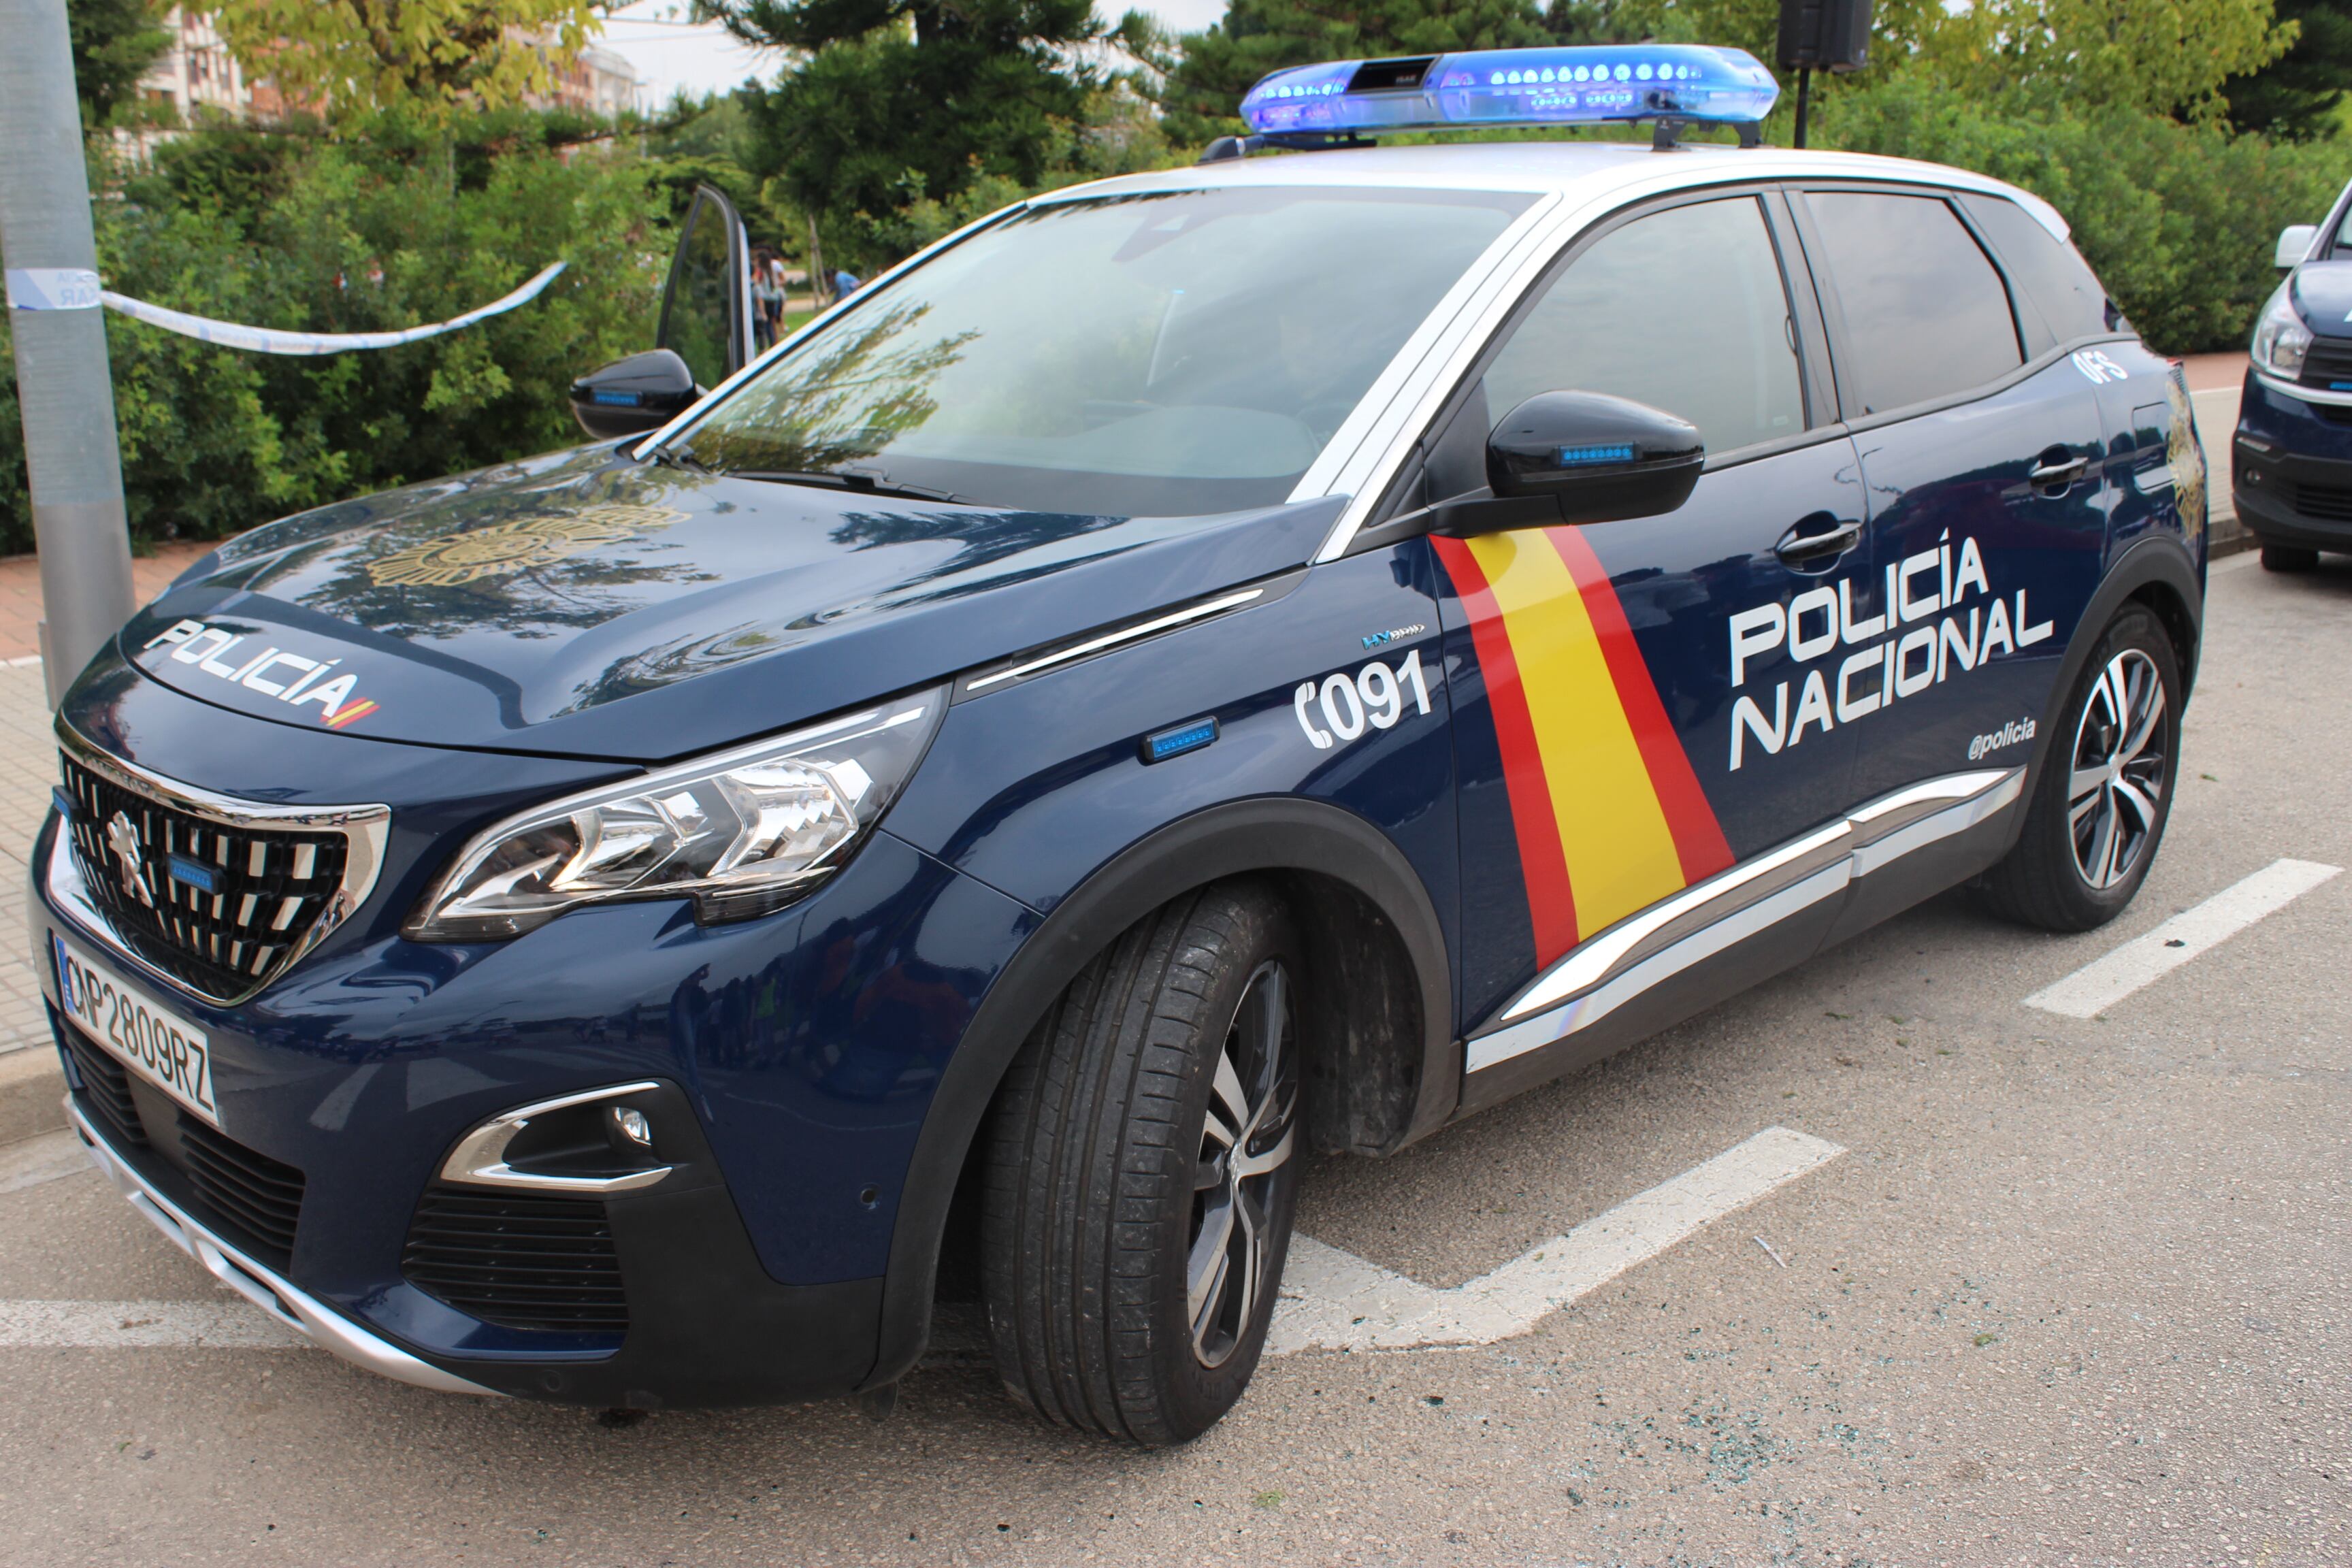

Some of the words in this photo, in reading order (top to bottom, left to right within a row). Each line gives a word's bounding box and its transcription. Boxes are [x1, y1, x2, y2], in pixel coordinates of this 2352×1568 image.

[1362, 623, 1425, 649] HYBRID
[1729, 527, 1989, 688] POLICÍA
[143, 619, 358, 718] POLICÍA
[1320, 649, 1431, 740] 091
[1729, 588, 2053, 772] NACIONAL
[1968, 717, 2036, 760] @policia
